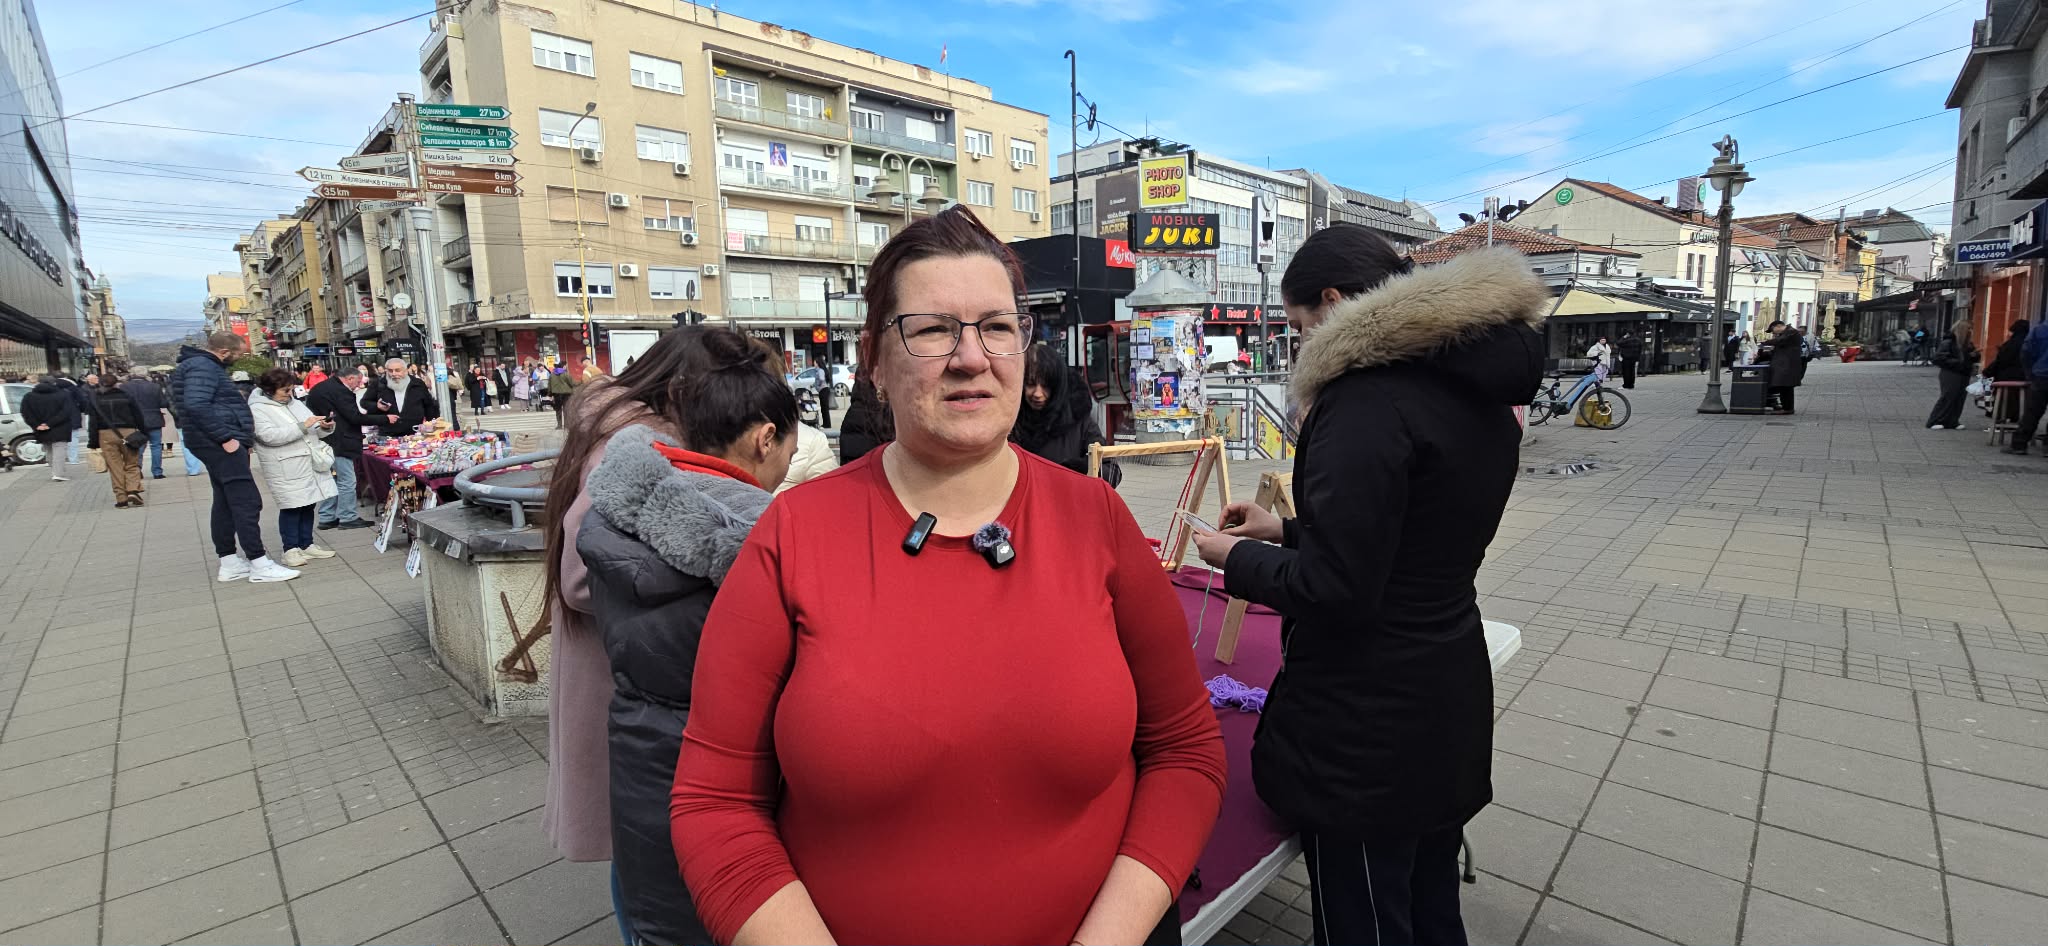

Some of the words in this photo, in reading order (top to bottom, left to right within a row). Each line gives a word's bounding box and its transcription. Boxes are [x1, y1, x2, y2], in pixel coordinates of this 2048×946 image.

[479, 108, 489, 117] 27
[489, 109, 501, 117] km
[487, 128, 495, 136] 17
[495, 128, 507, 137] km
[496, 139, 507, 147] km
[424, 152, 445, 161] Нишка
[446, 153, 463, 161] Бања
[488, 155, 496, 163] 12
[320, 171, 333, 180] km
[494, 172, 500, 180] 6
[500, 172, 512, 181] km
[1144, 166, 1184, 182] PHOTO
[336, 187, 350, 197] km
[445, 183, 462, 192] Кула
[494, 185, 500, 193] 4
[500, 185, 512, 194] km
[1147, 184, 1181, 199] SHOP
[1151, 215, 1206, 226] MOBILE
[1143, 227, 1215, 246] JUKI
